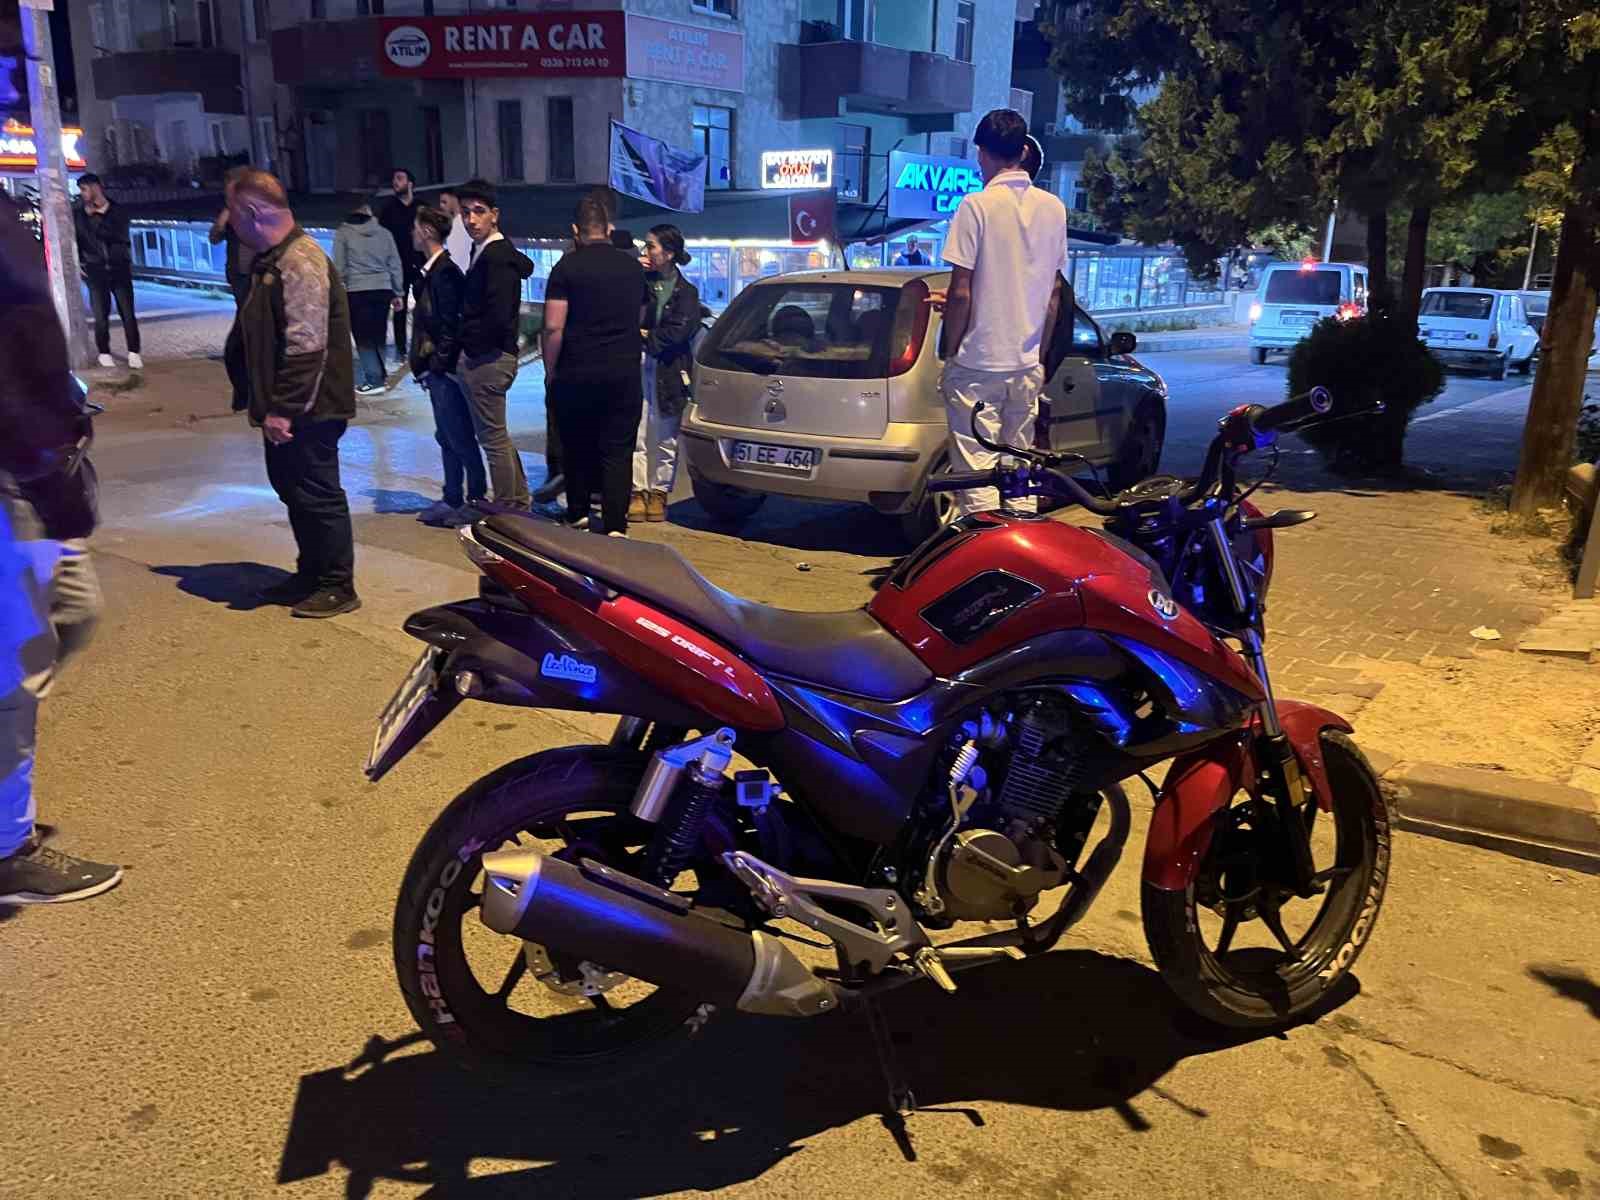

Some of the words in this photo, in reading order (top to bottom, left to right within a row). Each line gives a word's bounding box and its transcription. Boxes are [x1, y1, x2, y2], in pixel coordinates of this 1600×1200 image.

[444, 24, 513, 52] RENT
[521, 24, 539, 51] A
[547, 23, 606, 50] CAR
[737, 444, 752, 463] 51
[757, 446, 777, 464] EE
